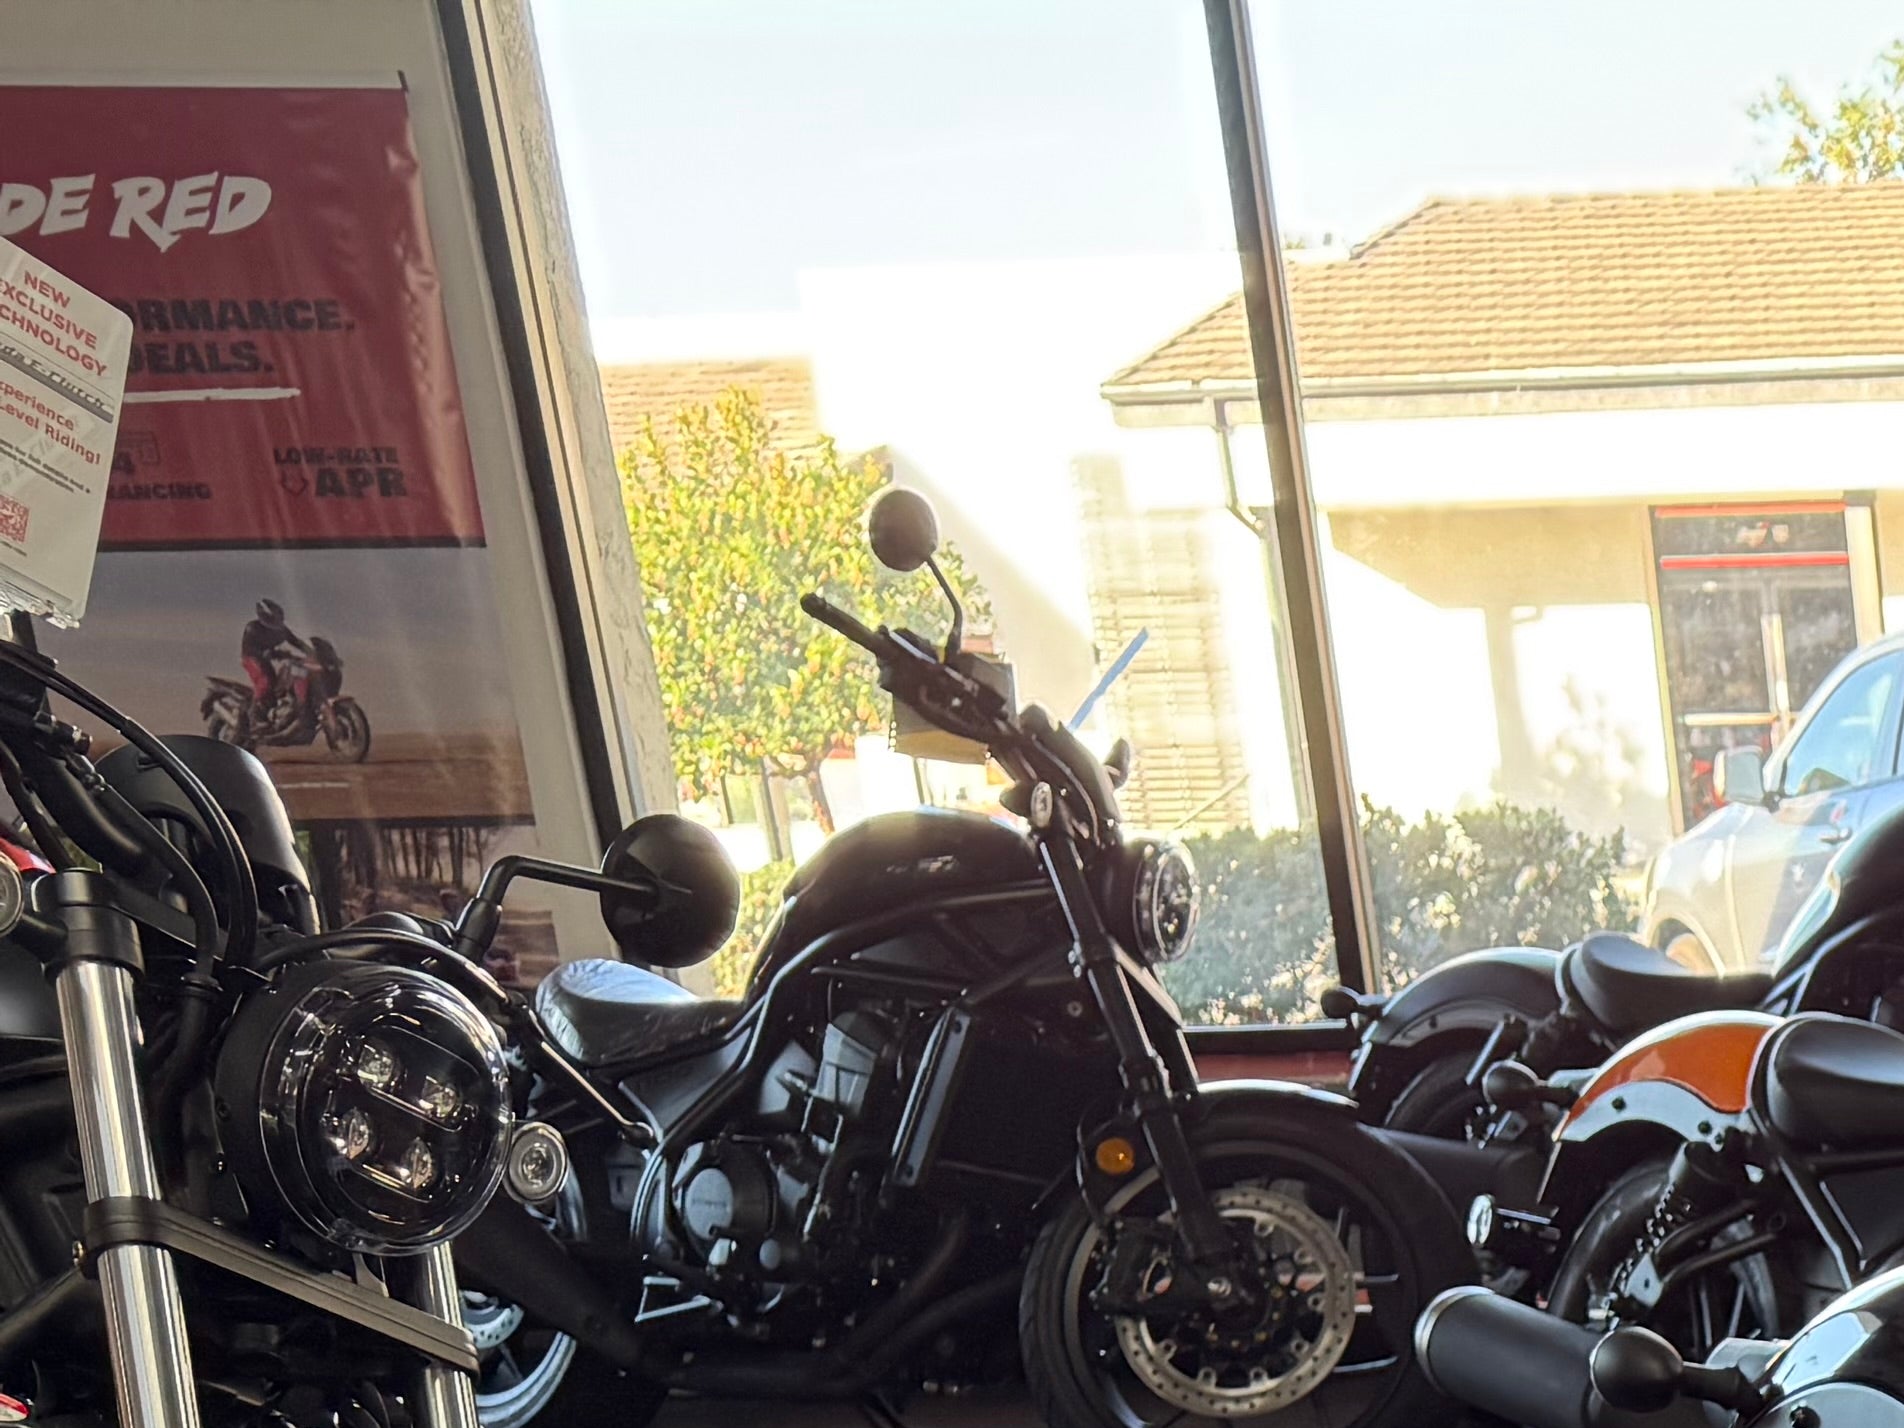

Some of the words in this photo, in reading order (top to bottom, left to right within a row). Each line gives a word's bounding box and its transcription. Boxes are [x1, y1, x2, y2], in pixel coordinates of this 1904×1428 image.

[109, 171, 272, 253] RED
[24, 270, 70, 309] NEW
[45, 423, 101, 466] Riding!
[314, 466, 407, 498] APR
